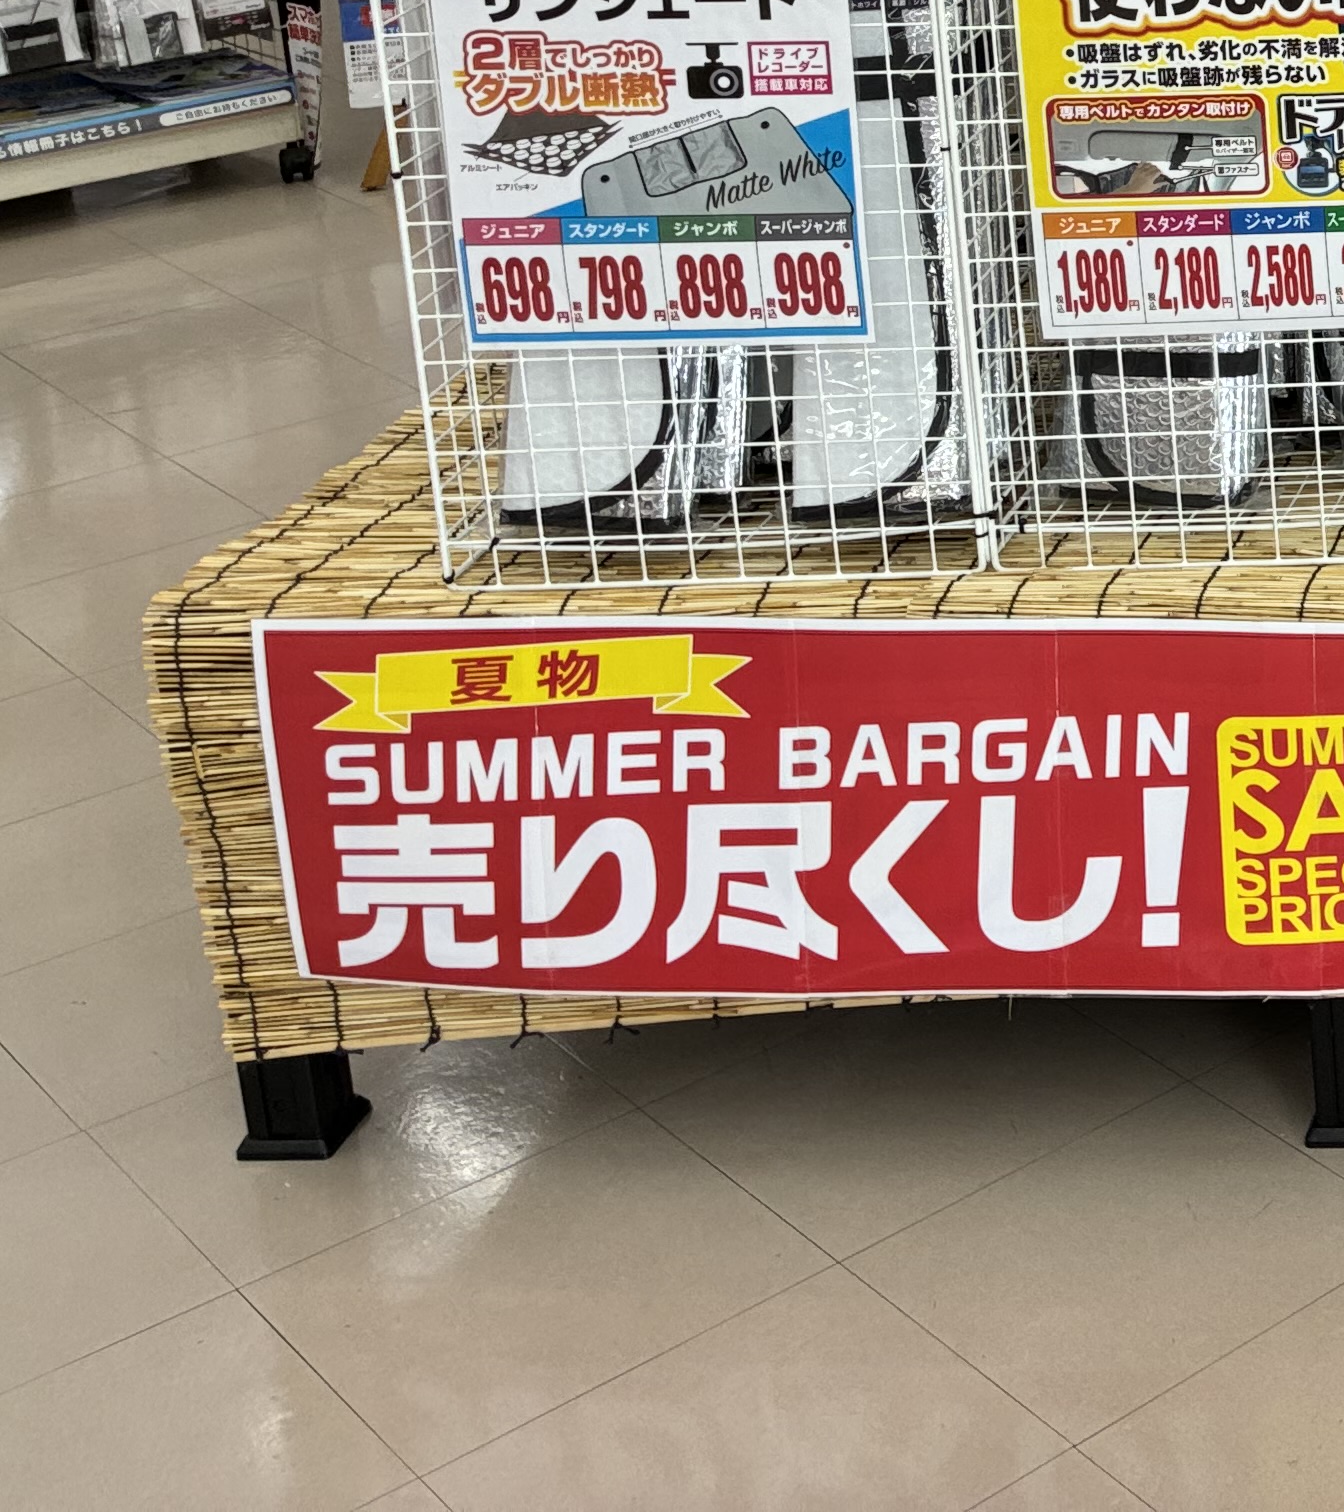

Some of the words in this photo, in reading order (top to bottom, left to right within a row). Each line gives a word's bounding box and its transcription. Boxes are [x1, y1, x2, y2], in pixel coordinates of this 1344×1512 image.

[470, 37, 662, 71] 2層でしっかり
[470, 69, 663, 113] ダブル断熱
[755, 77, 828, 93] 搭載車対応
[1057, 101, 1252, 121] 専用ベルトでカンタン取付け
[706, 174, 773, 211] Matte
[780, 147, 847, 186] White
[480, 222, 545, 238] ジュニア
[569, 221, 649, 237] スタンダード
[675, 220, 738, 236] ジャンボ
[761, 218, 848, 235] スーパージャンボ
[450, 651, 601, 700] 夏物
[325, 728, 724, 805] SUMMER
[778, 712, 1190, 789] BARGAIN
[333, 784, 1190, 970] 売り尽くし!
